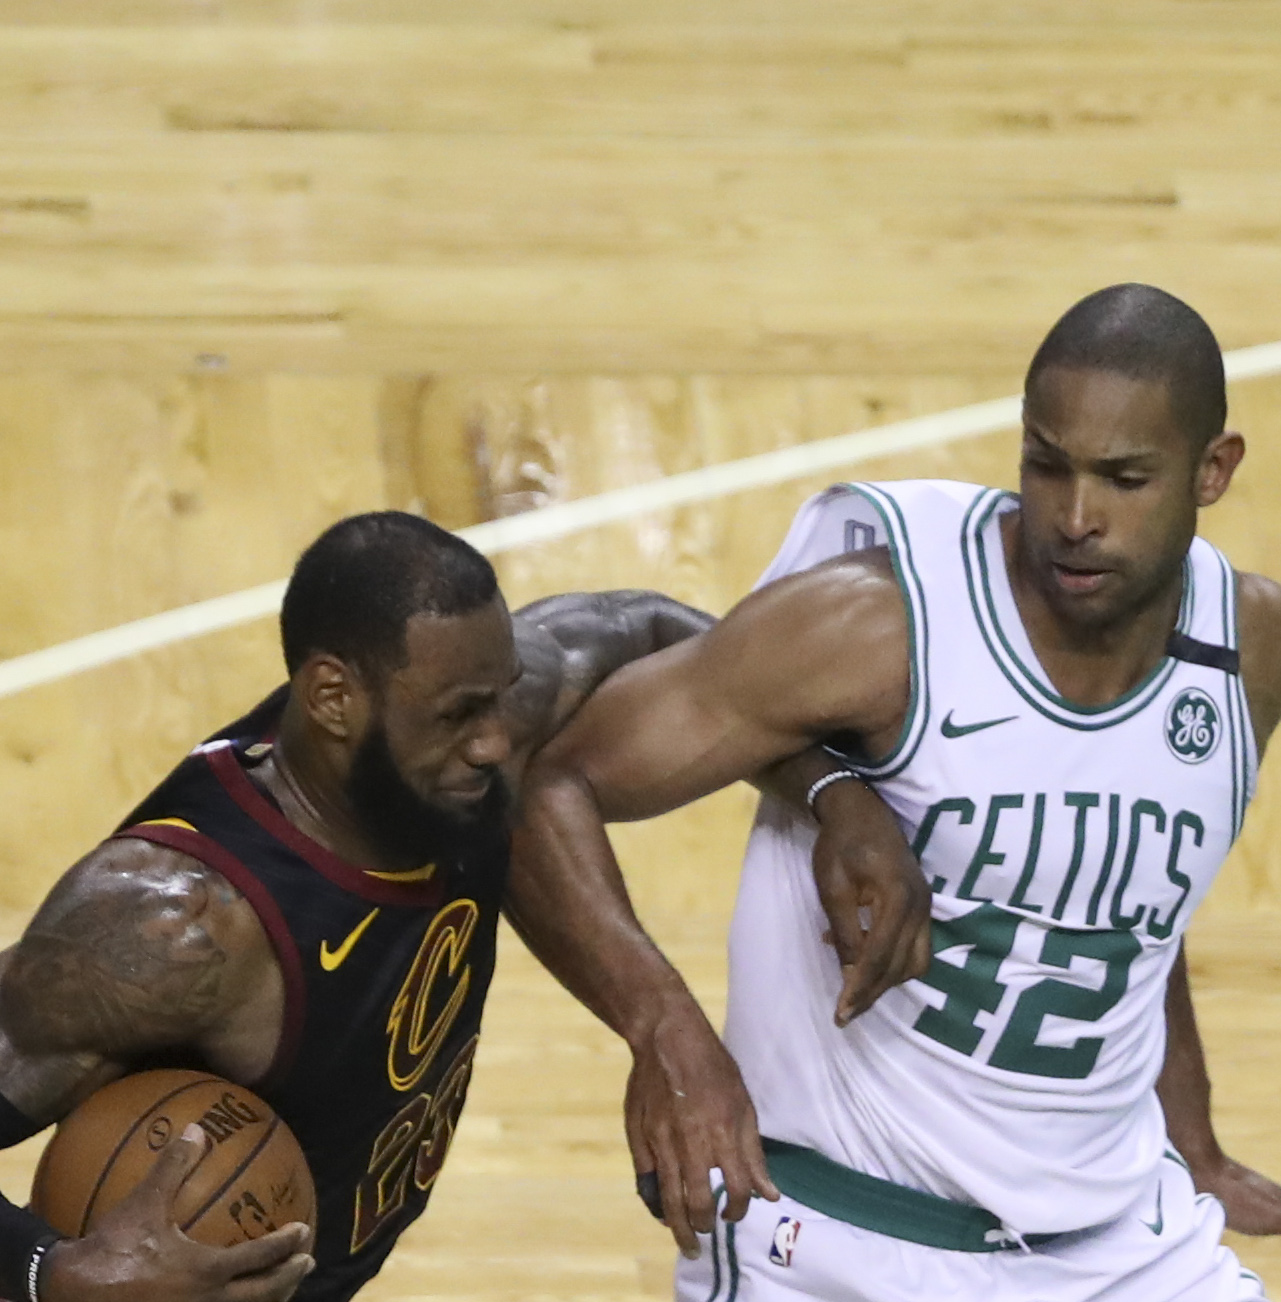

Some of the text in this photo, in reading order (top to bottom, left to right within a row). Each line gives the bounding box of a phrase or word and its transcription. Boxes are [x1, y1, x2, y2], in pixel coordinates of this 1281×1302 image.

[913, 791, 1206, 939] CELTICS
[386, 898, 479, 1091] C
[913, 901, 1144, 1080] 42
